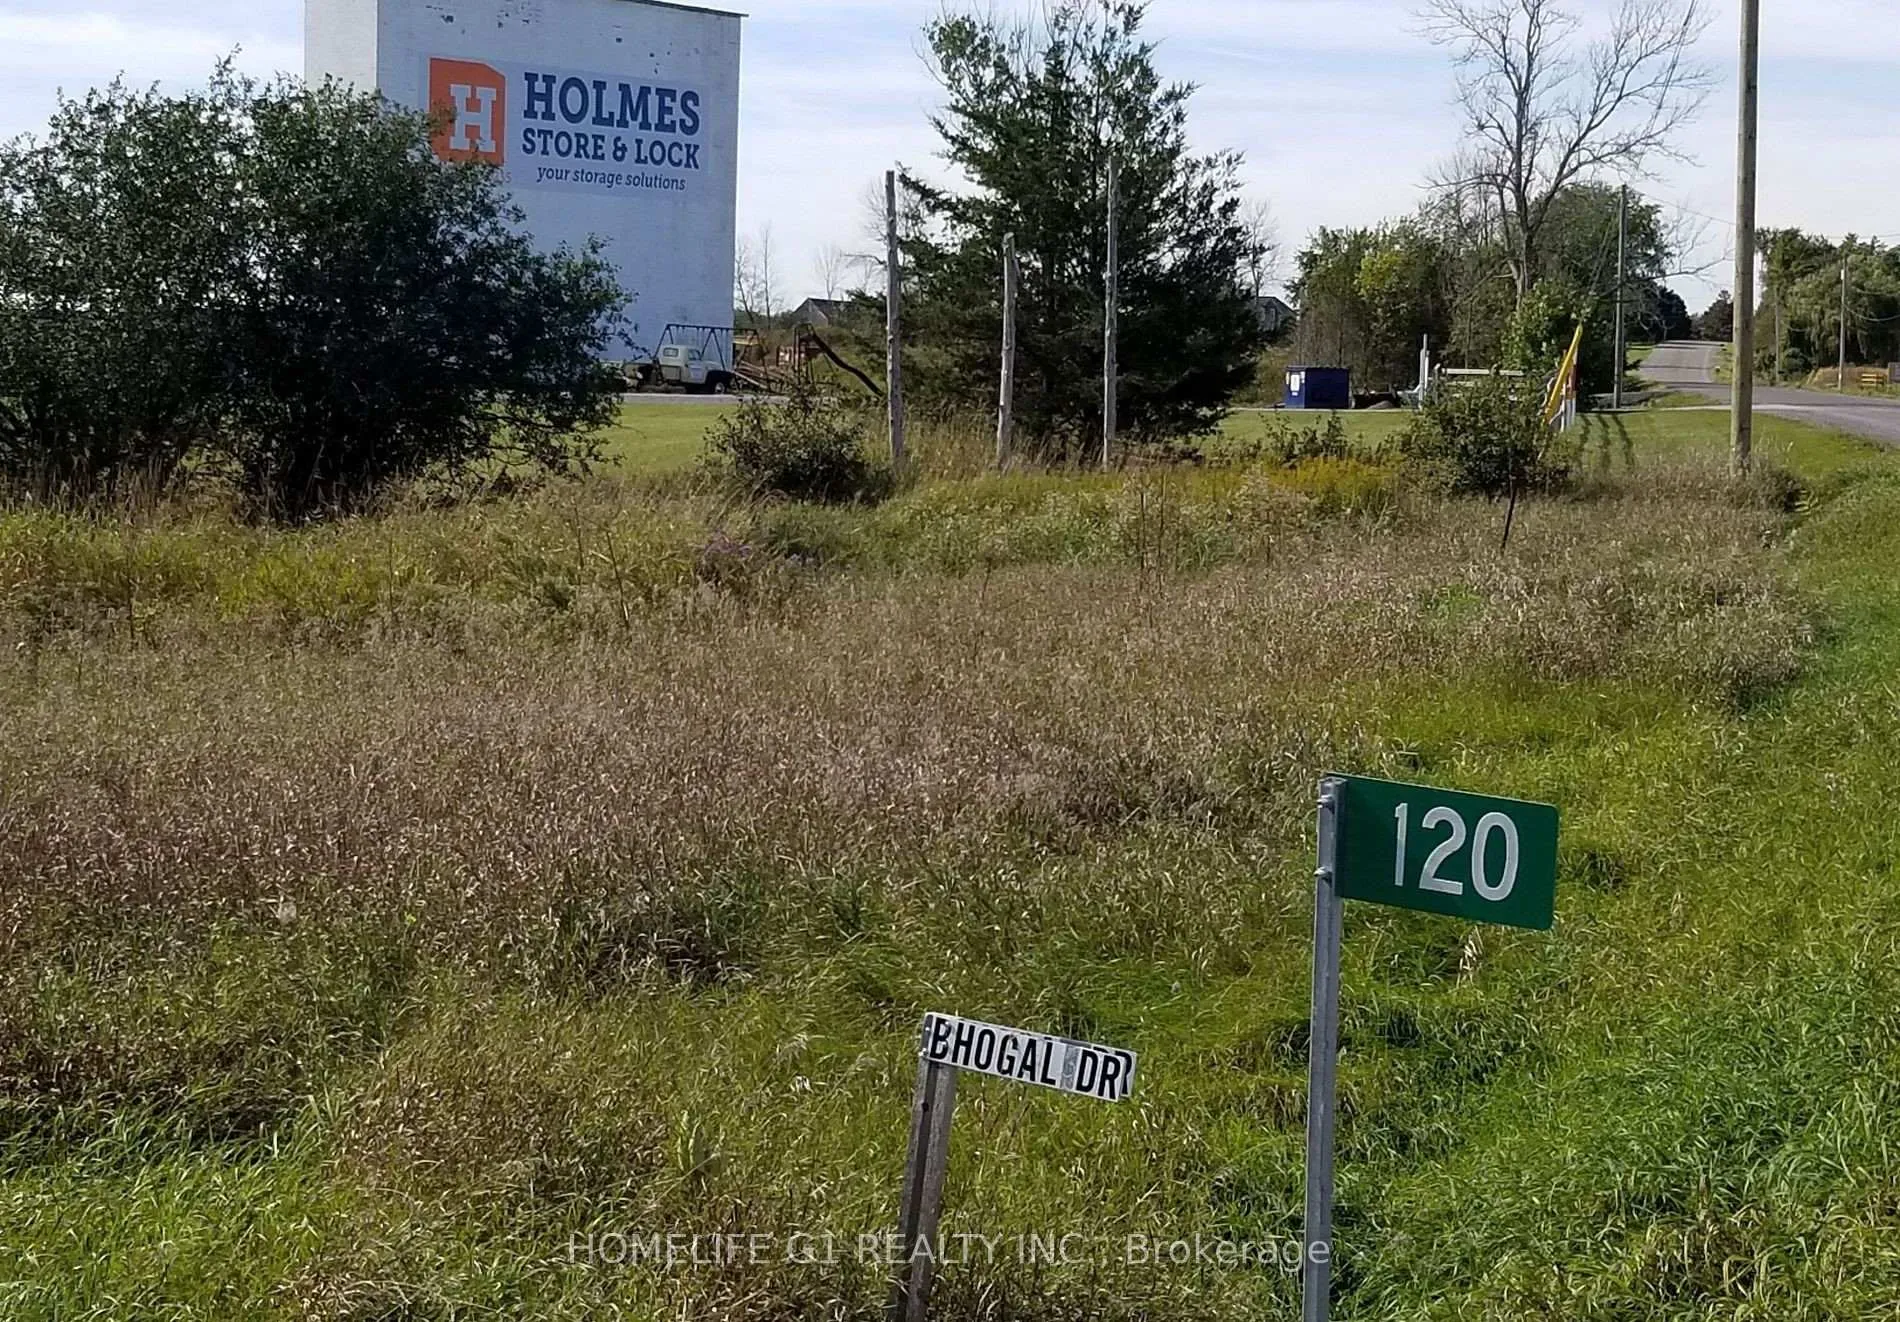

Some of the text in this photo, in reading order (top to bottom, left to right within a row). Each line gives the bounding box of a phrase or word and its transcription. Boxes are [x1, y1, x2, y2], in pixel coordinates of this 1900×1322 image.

[450, 84, 496, 152] H
[523, 72, 700, 136] HOLMES
[522, 127, 700, 170] STORE & LOCK
[536, 166, 686, 191] your storage solutions
[1394, 802, 1520, 901] 120
[929, 1016, 1057, 1086] BHOGAL
